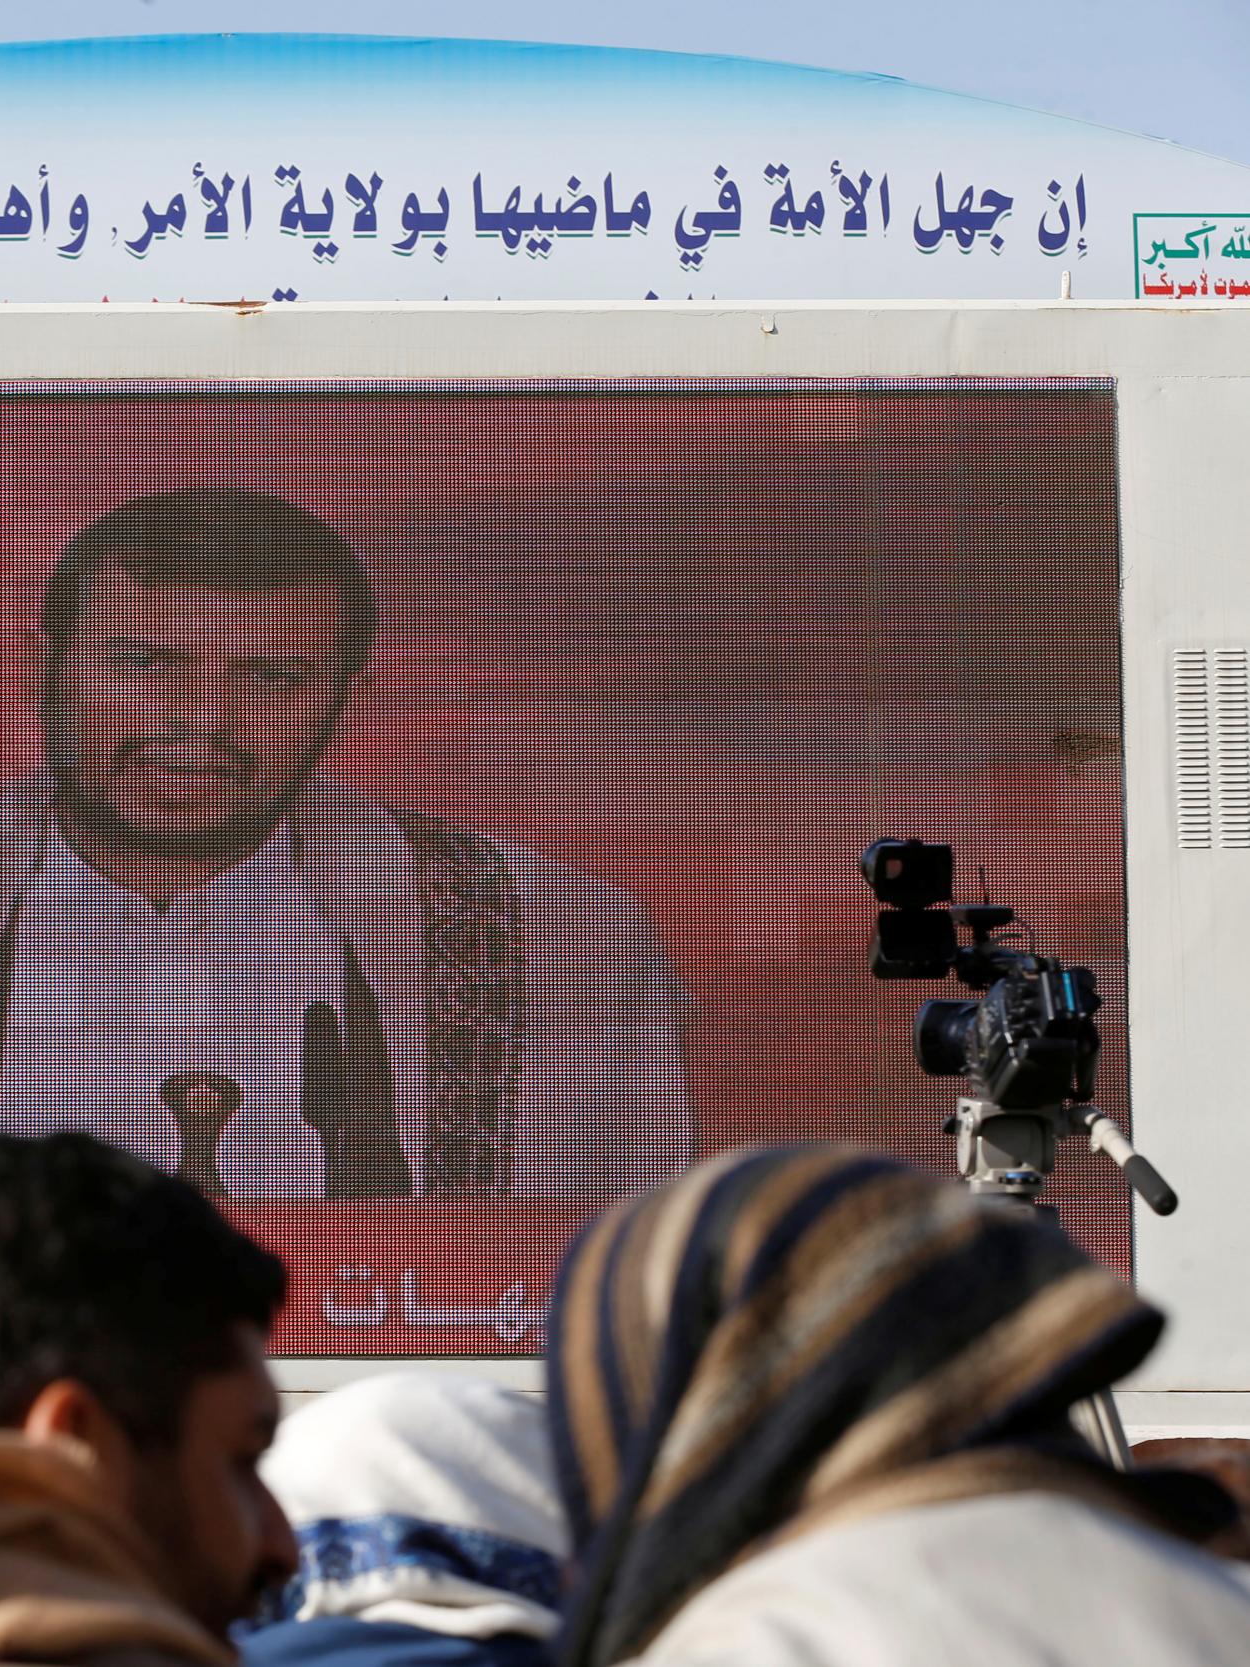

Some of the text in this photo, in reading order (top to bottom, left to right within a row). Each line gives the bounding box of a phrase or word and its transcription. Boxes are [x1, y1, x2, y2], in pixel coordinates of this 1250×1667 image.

[273, 164, 451, 260] بولاية
[472, 171, 652, 255] ماضيها
[674, 164, 741, 267] في
[762, 160, 891, 234] الأمة
[913, 170, 1014, 253] جهل
[1037, 171, 1087, 254] إن
[1141, 219, 1217, 270] أكبر
